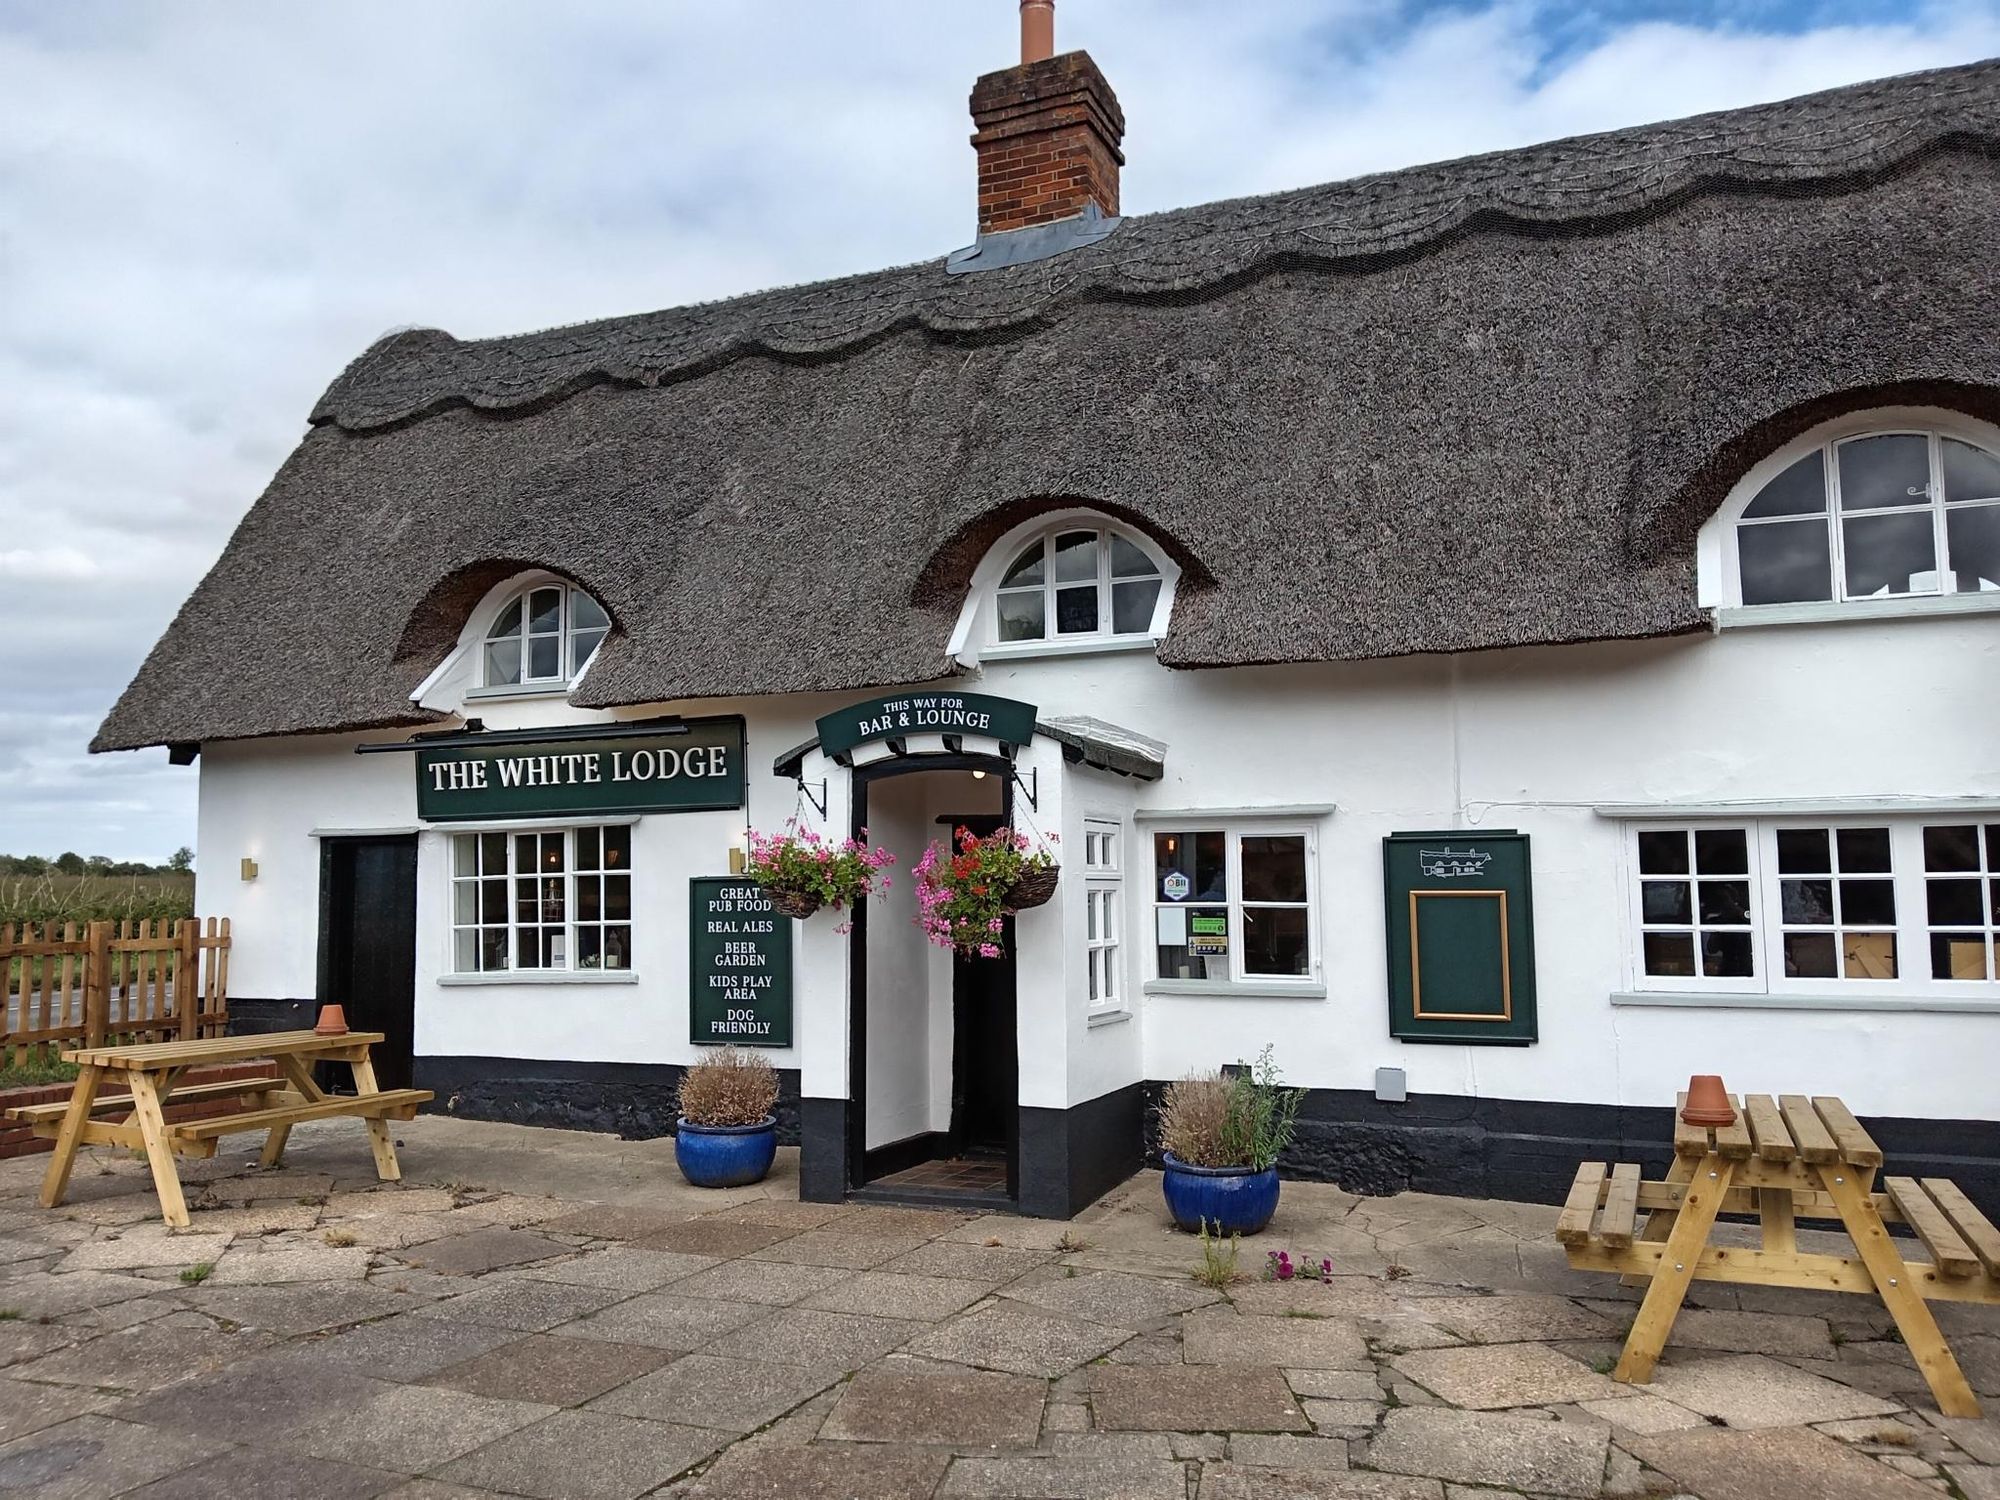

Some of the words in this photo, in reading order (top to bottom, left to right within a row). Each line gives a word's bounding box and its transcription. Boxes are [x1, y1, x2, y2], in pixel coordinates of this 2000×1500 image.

[883, 700, 909, 713] THIS
[912, 698, 937, 709] WAY
[941, 698, 963, 709] FOR
[858, 715, 893, 736] BAR
[899, 712, 910, 727] &
[917, 710, 990, 729] LOUNGE
[428, 760, 488, 791] THE
[496, 753, 602, 787] WHITE
[611, 746, 728, 782] LODGE
[720, 887, 760, 900] GREAT
[709, 900, 732, 912] PUB
[737, 899, 772, 911] FOOD
[707, 921, 738, 933] REAL
[742, 920, 773, 932] ALES
[725, 942, 756, 954] BEER
[715, 954, 766, 966] GARDEN
[709, 975, 738, 987] KIDS
[742, 975, 772, 987] PLAY
[724, 988, 757, 1000] AREA
[727, 1009, 754, 1021] DOG
[711, 1021, 771, 1034] FRIENDLY
